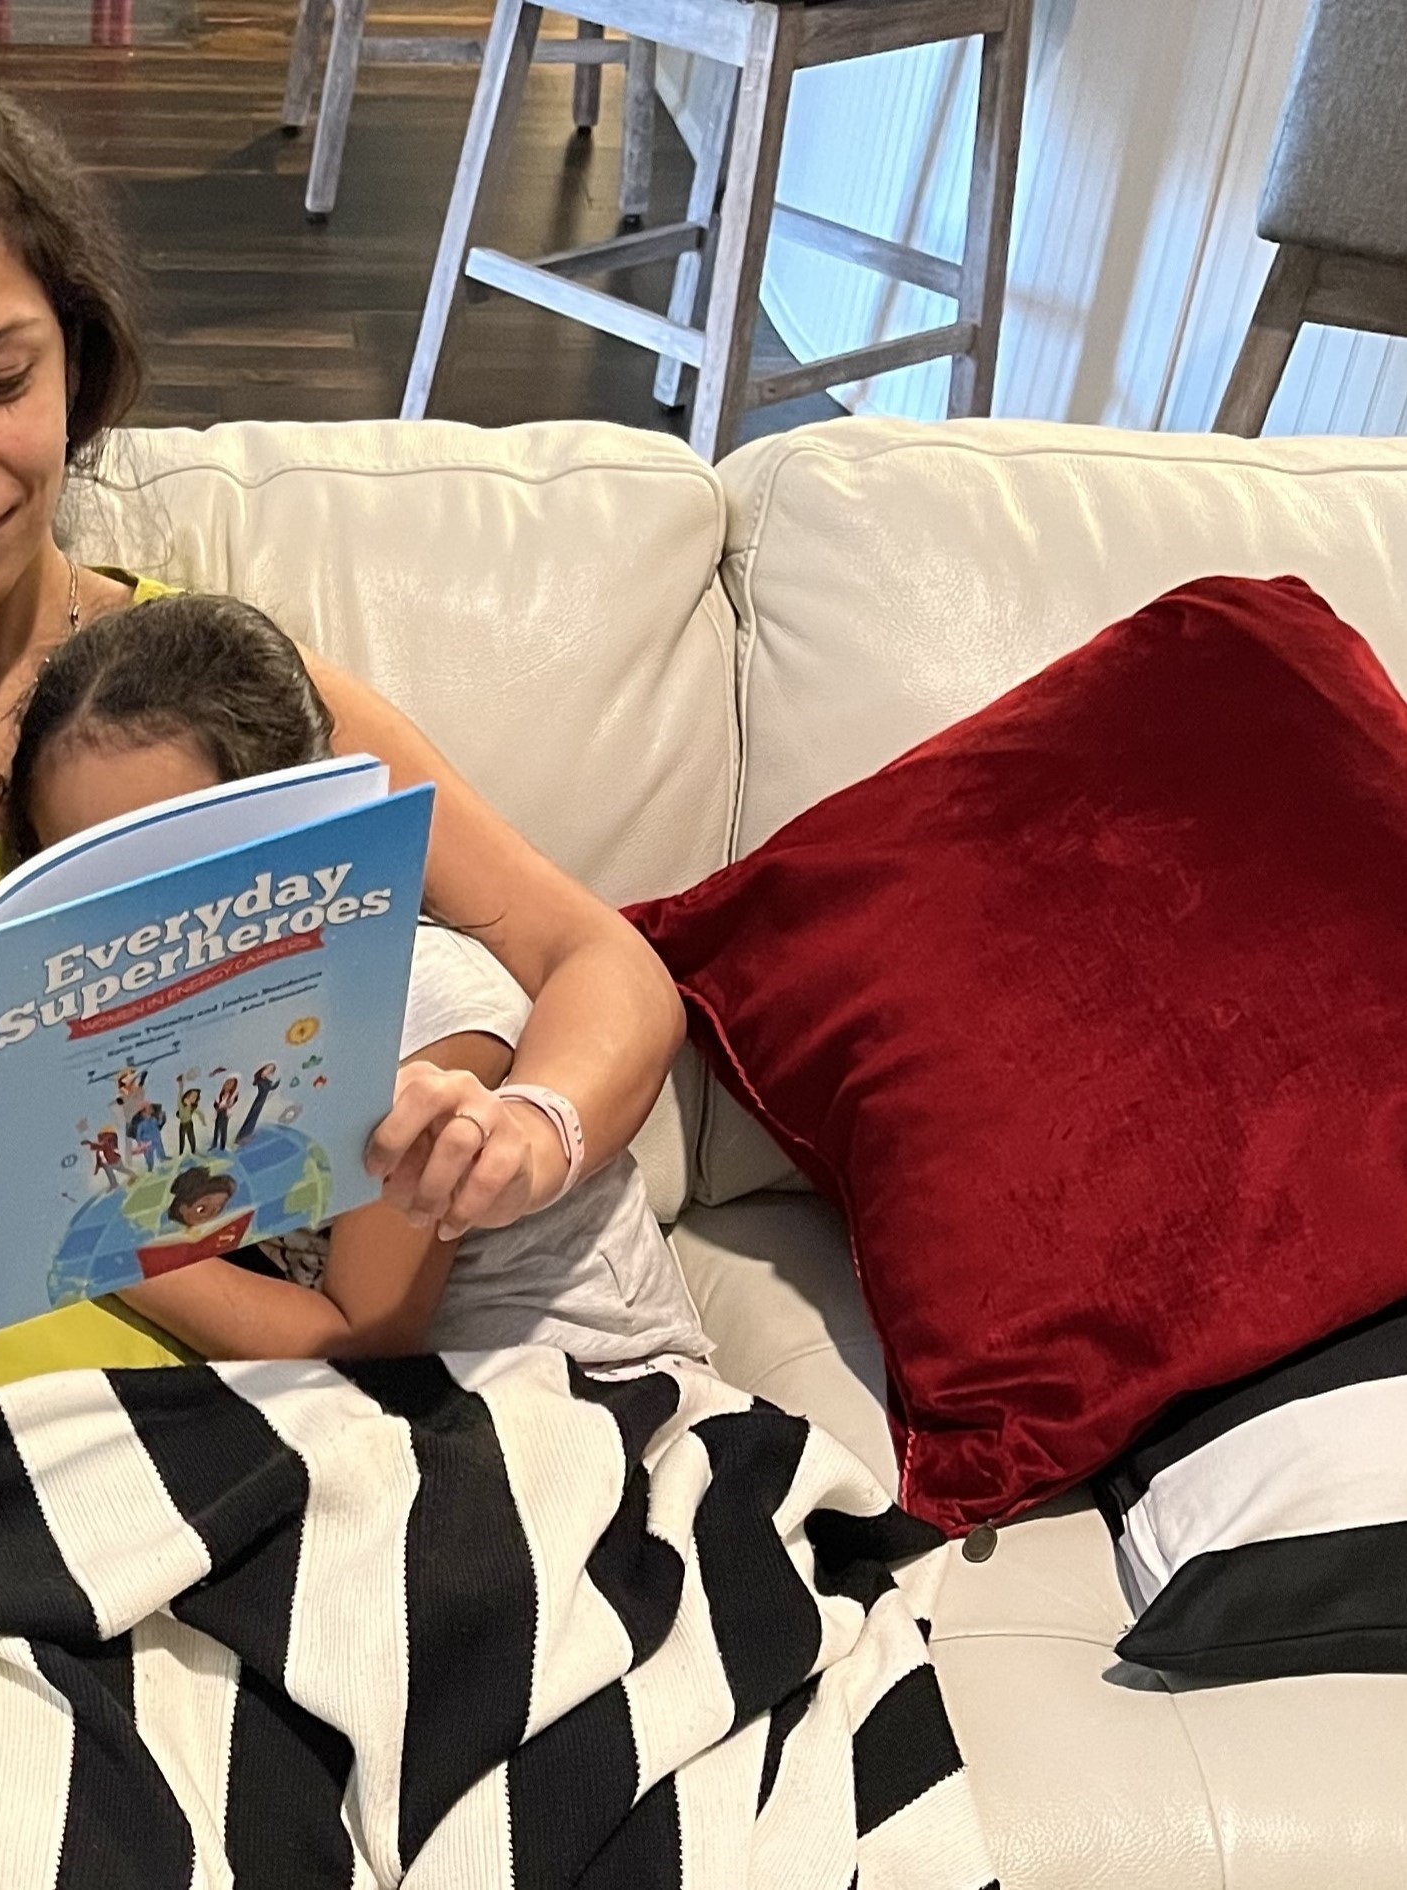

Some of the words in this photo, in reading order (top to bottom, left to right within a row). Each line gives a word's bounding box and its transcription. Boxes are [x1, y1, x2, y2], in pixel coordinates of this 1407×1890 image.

[43, 861, 354, 996] Everyday
[80, 1002, 145, 1031] WOMEN
[147, 996, 165, 1010] IN
[166, 962, 234, 1001] ENERGY
[234, 937, 312, 970] CAREERS
